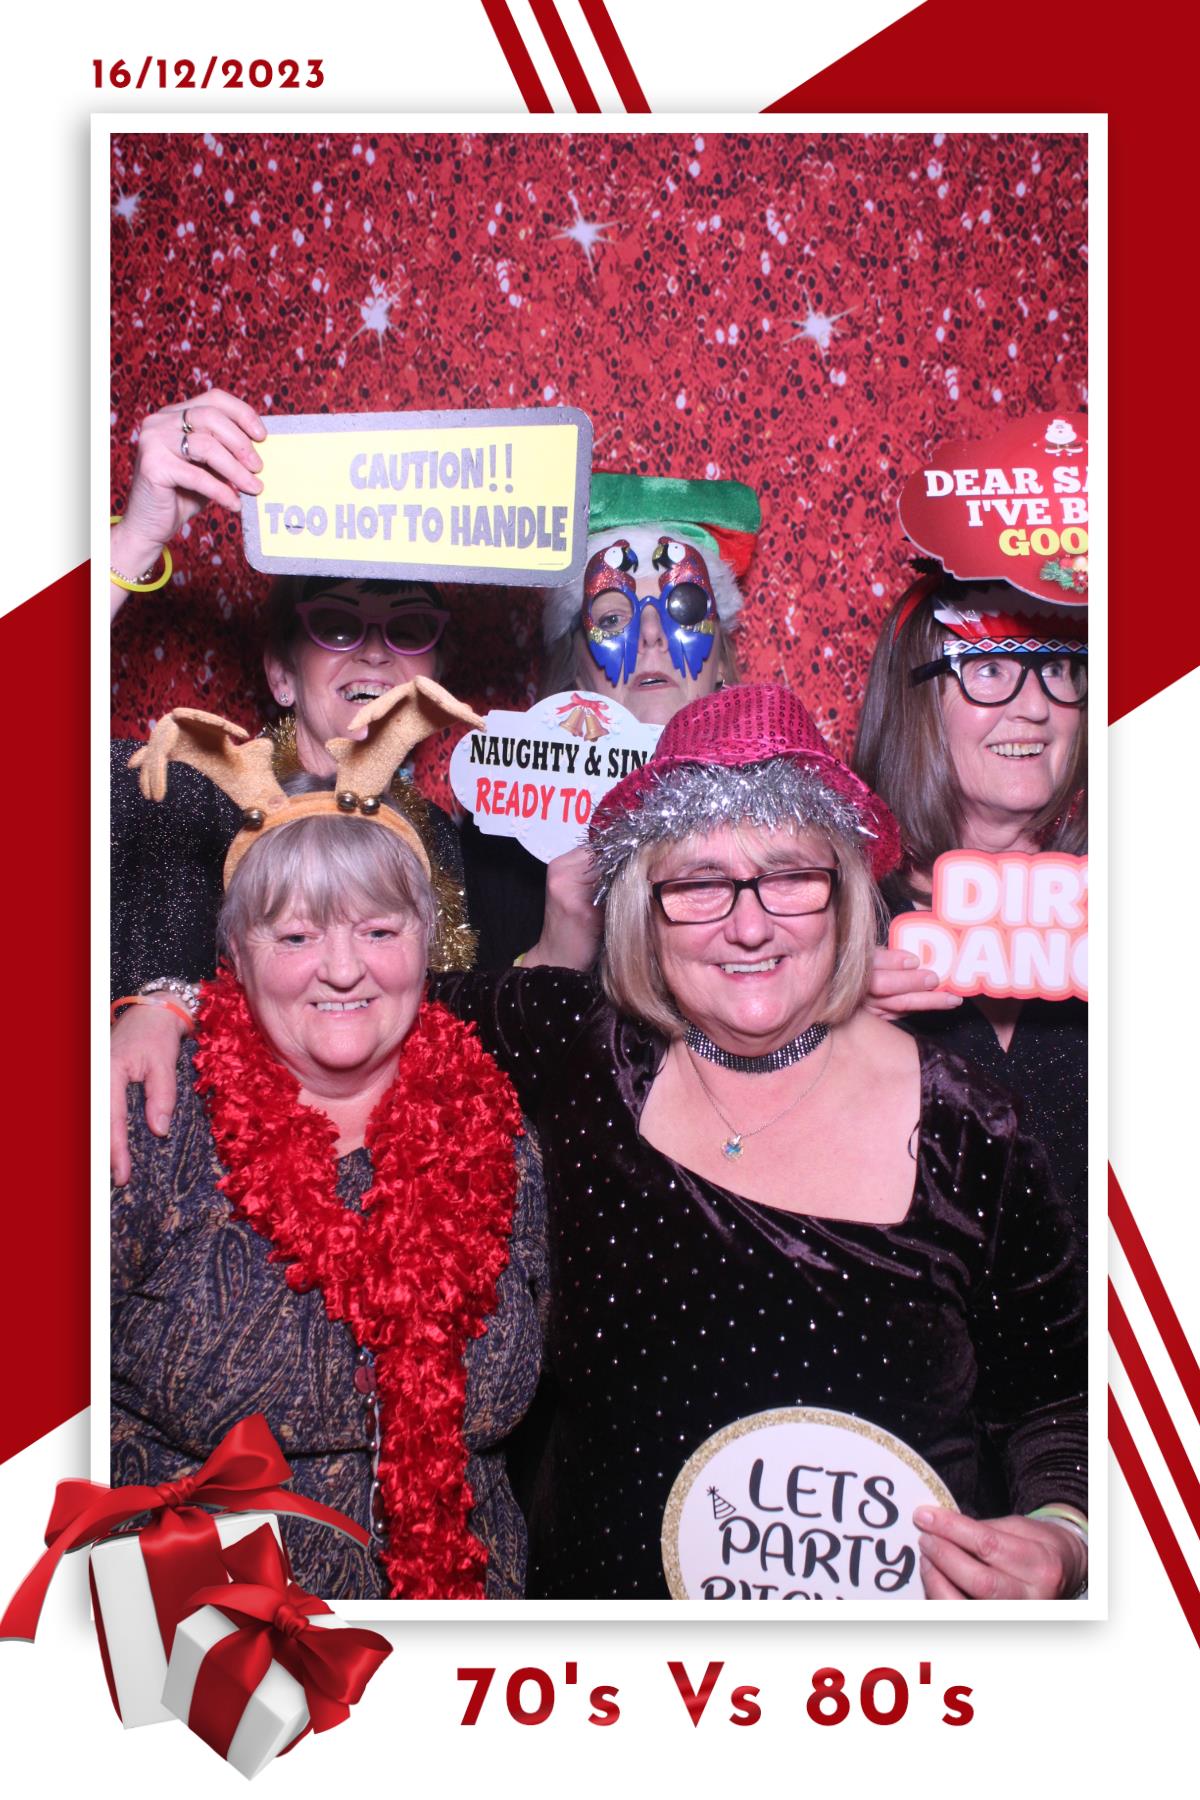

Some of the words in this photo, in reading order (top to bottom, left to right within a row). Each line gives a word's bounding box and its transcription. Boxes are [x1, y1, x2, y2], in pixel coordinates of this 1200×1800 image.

[349, 443, 514, 494] CAUTION!!
[924, 467, 1044, 497] DEAR
[1052, 465, 1088, 493] S
[264, 502, 328, 537] TOO
[335, 503, 397, 541] HOT
[403, 504, 444, 544] TO
[450, 504, 568, 552] HANDLE
[966, 498, 1052, 527] I'VE
[470, 733, 580, 774] NAUGHTY
[584, 745, 602, 777] &
[607, 747, 655, 779] SIN
[475, 776, 556, 822] READY
[560, 787, 592, 824] TO
[942, 860, 1088, 928] DIR
[748, 1458, 900, 1529] LETS
[718, 1515, 916, 1593] PARTY
